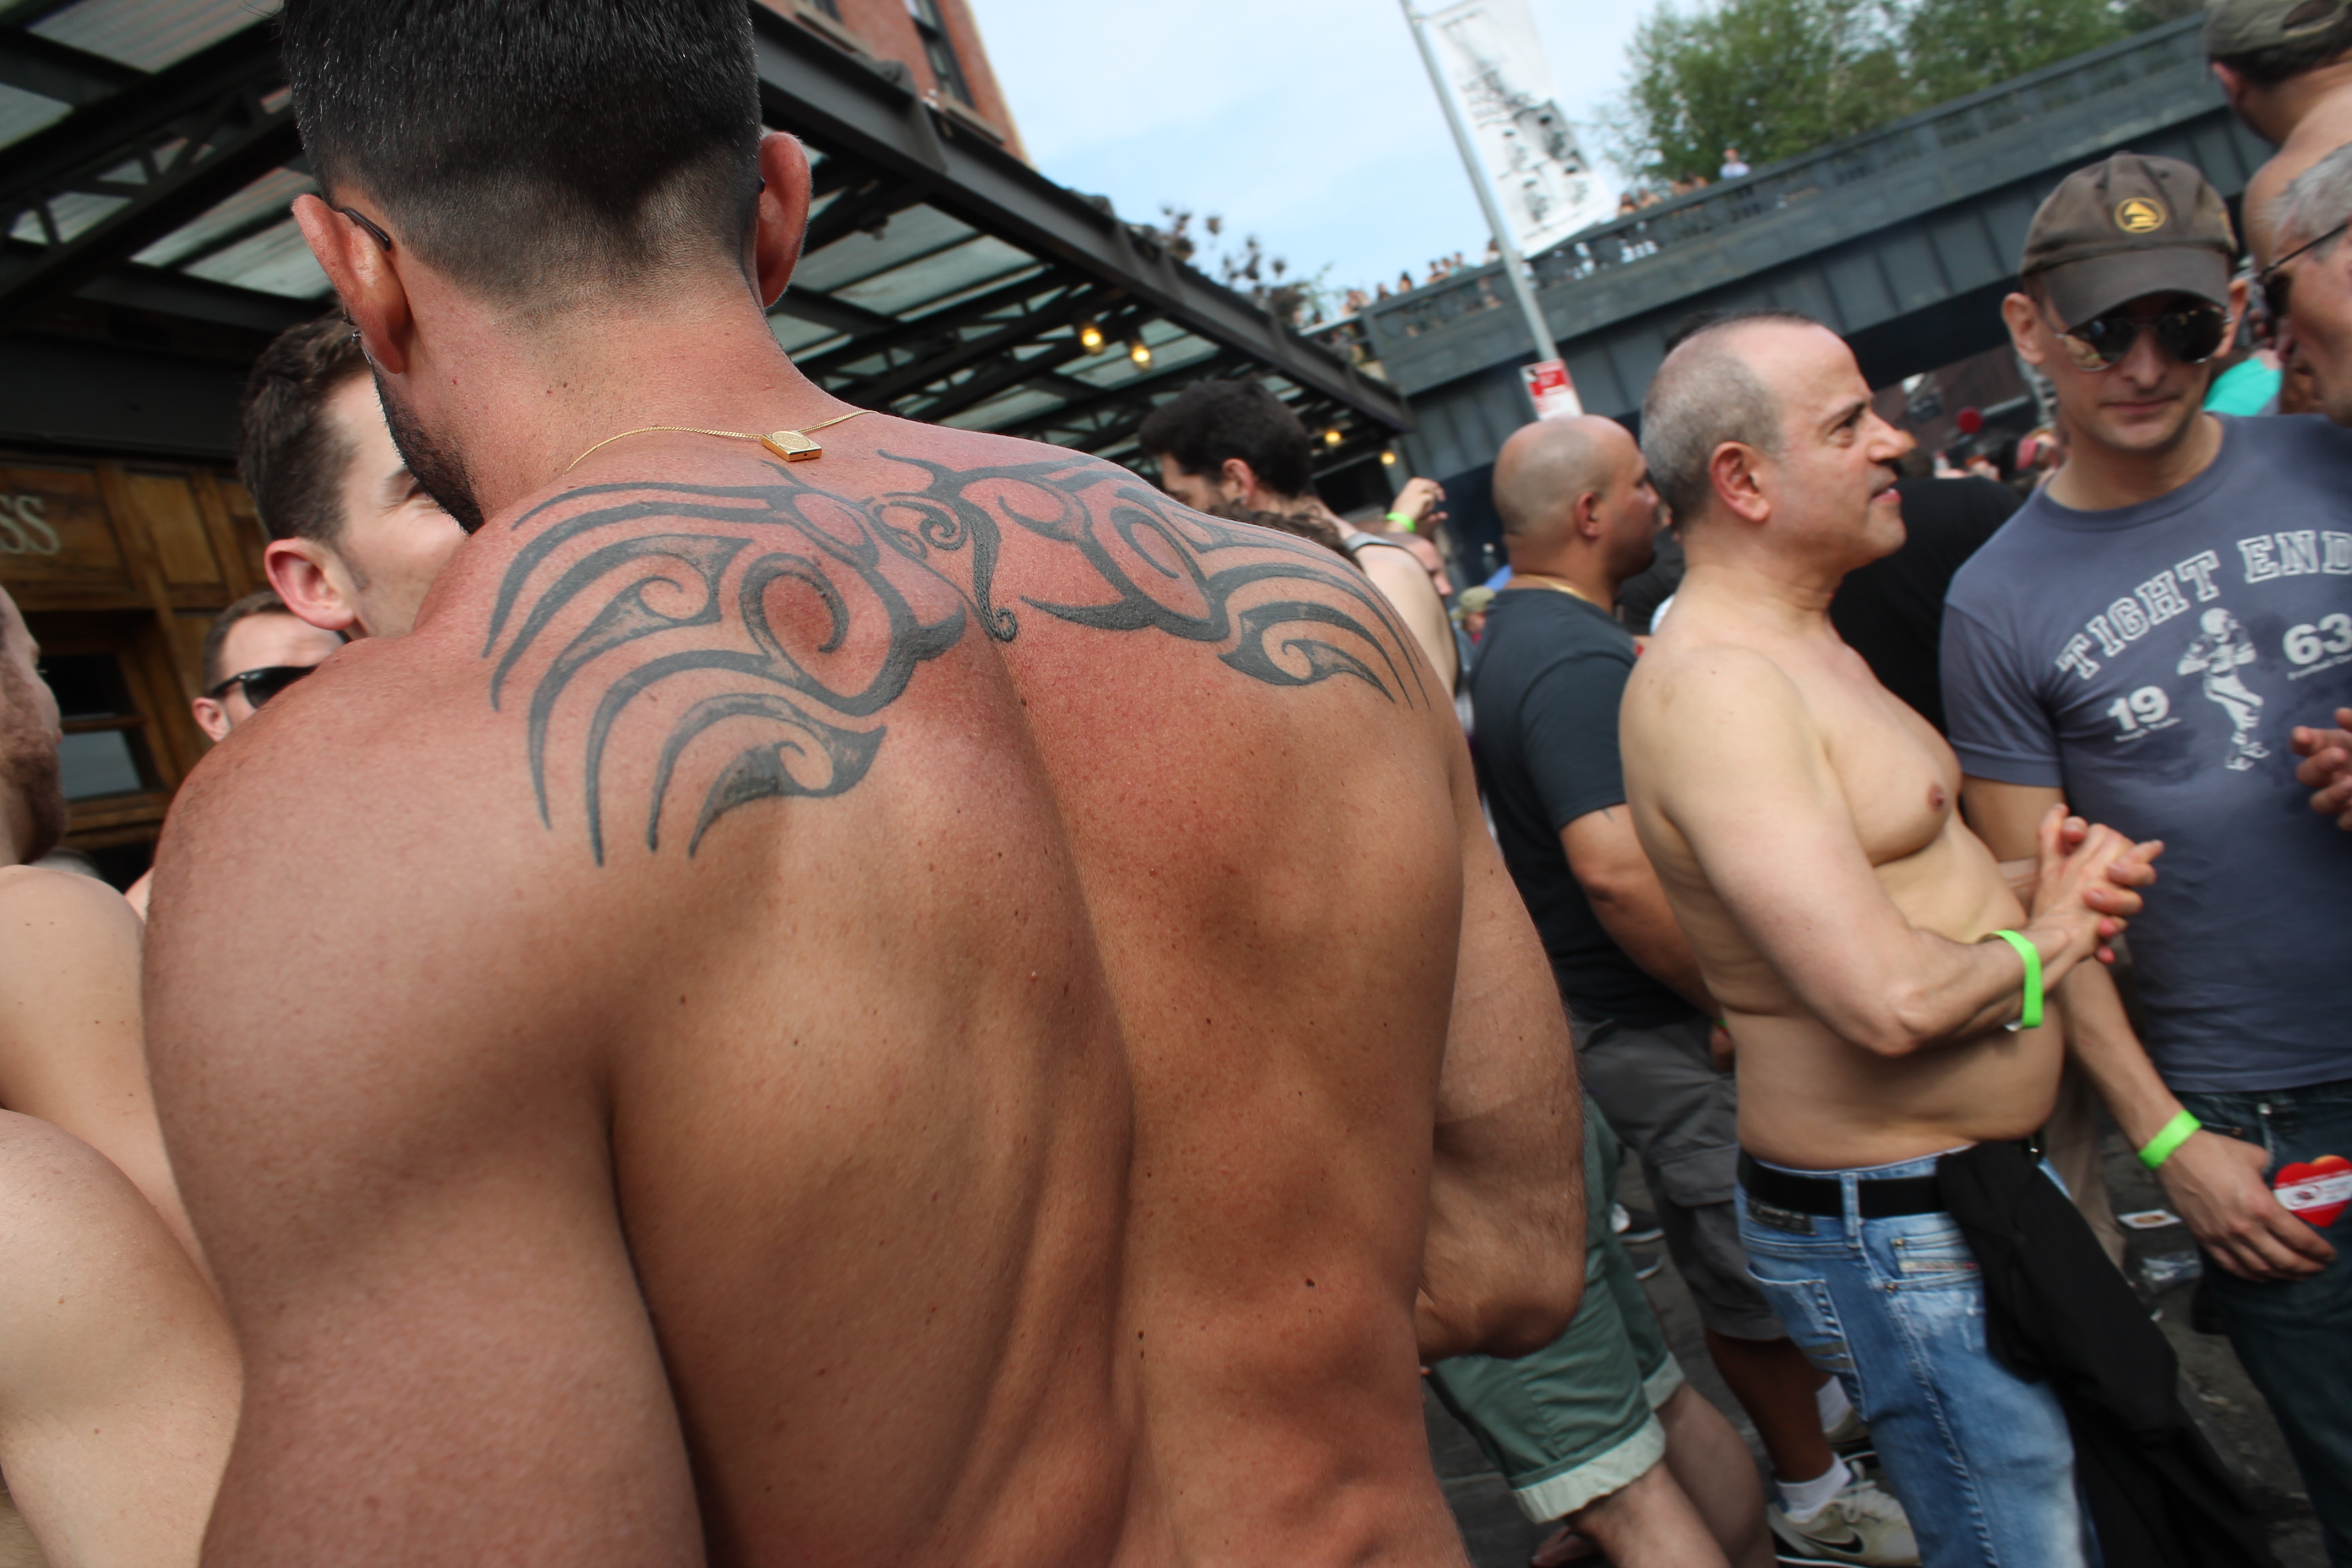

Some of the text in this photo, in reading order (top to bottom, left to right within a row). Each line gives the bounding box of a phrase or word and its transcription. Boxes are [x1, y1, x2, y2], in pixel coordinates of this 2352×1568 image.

[2055, 530, 2352, 680] TIGHT END
[2282, 612, 2352, 665] 63
[2106, 685, 2170, 731] 19
